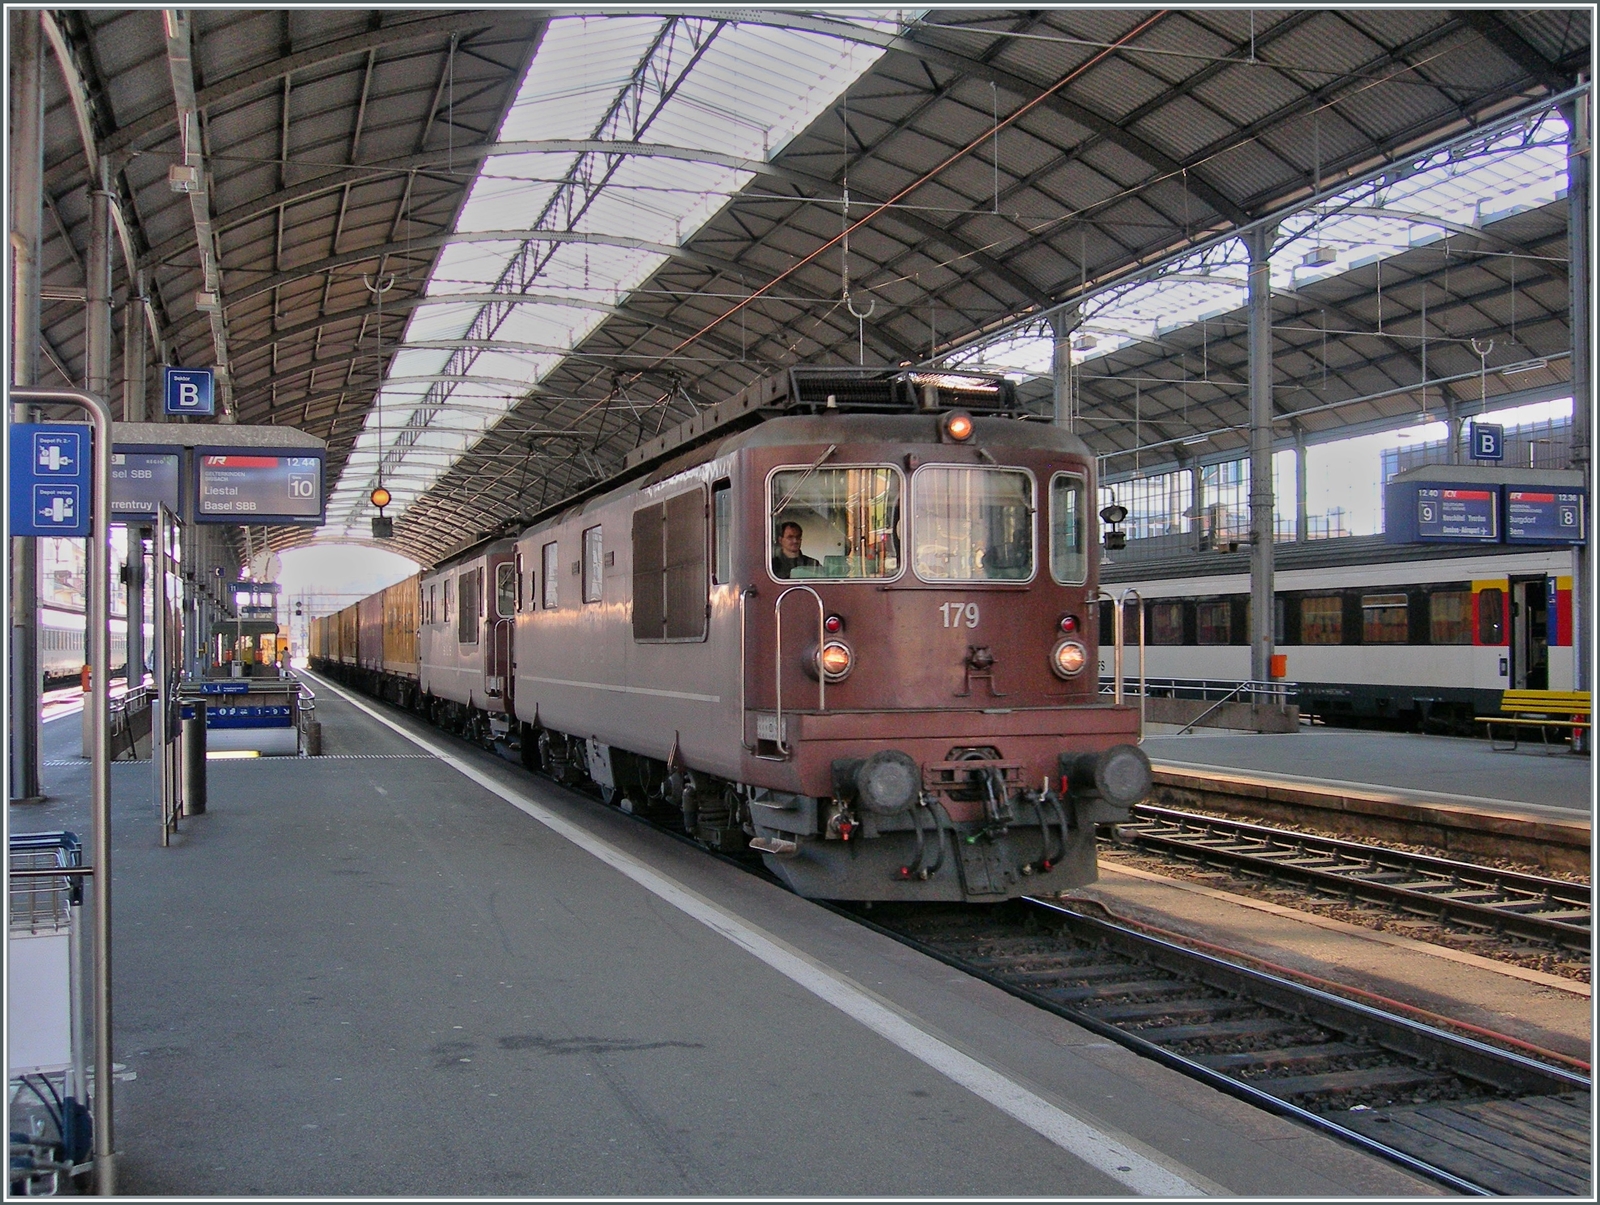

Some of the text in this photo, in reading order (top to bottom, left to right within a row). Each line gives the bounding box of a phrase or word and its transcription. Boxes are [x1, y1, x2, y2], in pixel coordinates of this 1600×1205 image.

[180, 383, 199, 406] B
[1482, 434, 1495, 453] B
[207, 456, 228, 465] IR
[112, 469, 153, 479] sel SBB
[204, 486, 239, 496] Liestal
[291, 480, 314, 497] 10
[111, 500, 153, 511] rrentruy
[204, 501, 257, 511] Basel SBB
[1423, 507, 1433, 521] 9
[1564, 511, 1573, 525] 8
[1548, 579, 1555, 595] 1
[939, 602, 980, 629] 179
